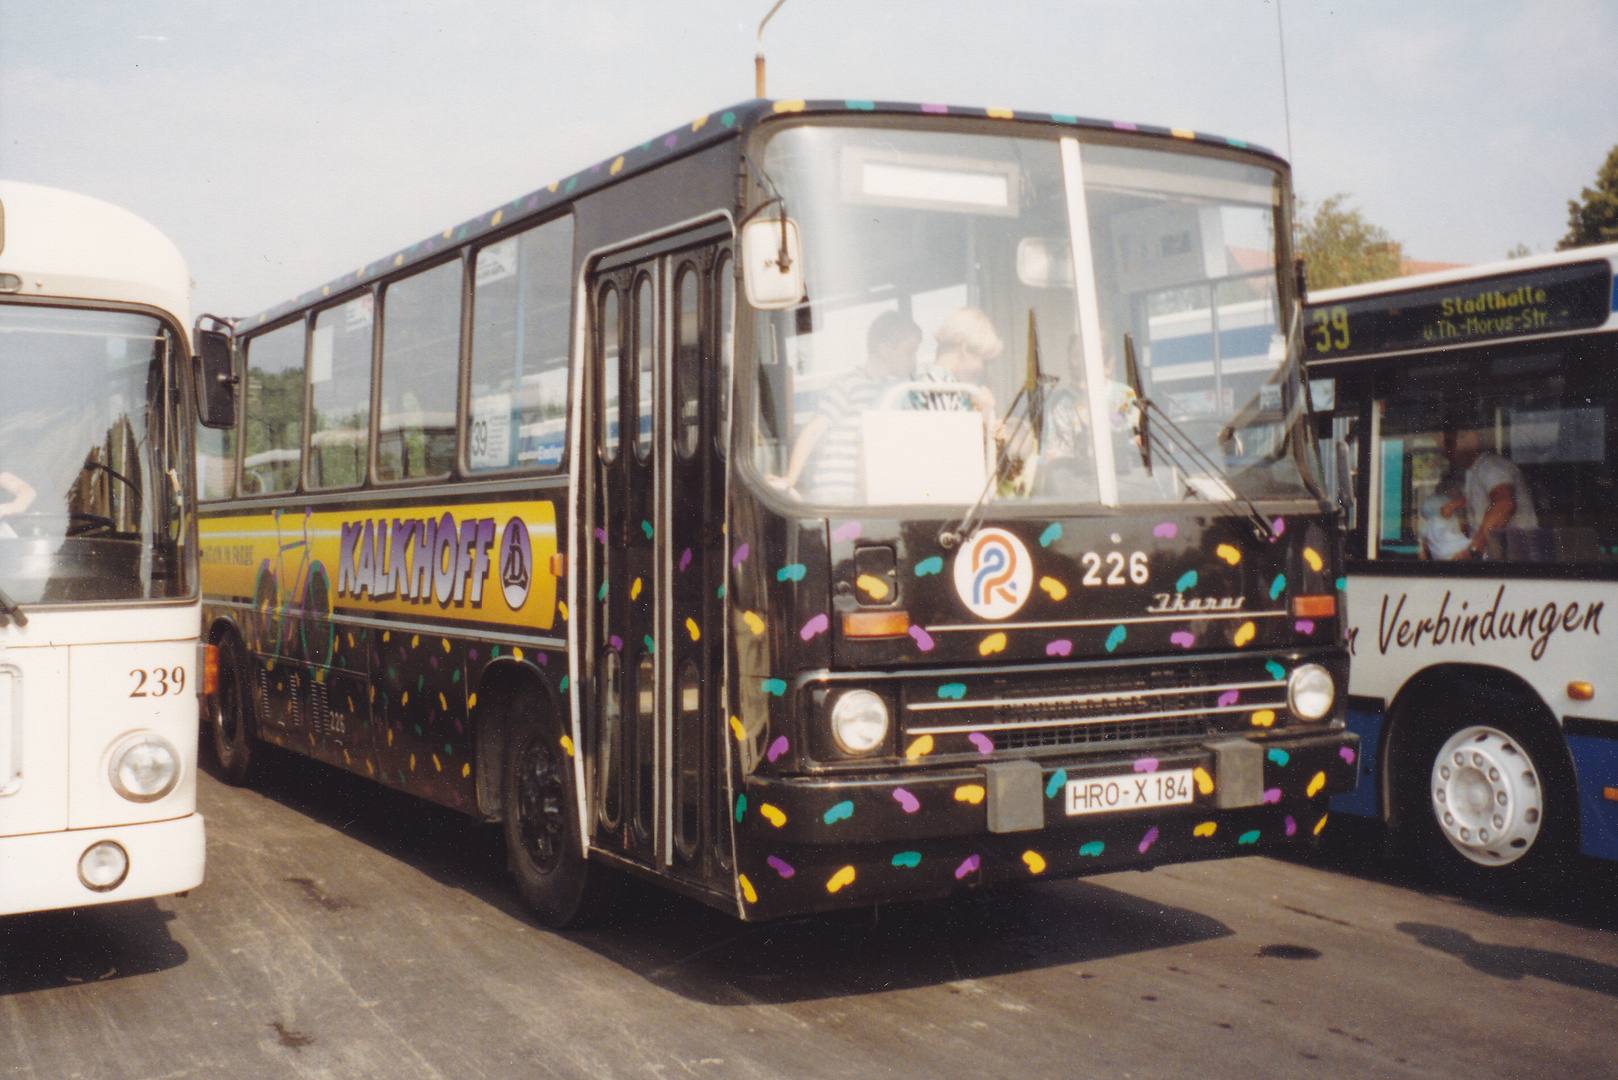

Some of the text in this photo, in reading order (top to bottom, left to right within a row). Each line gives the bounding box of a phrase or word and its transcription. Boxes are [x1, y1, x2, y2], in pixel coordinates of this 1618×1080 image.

[1441, 285, 1547, 317] Stadthalle
[1312, 306, 1350, 352] 39
[472, 420, 488, 456] 39
[338, 511, 497, 610] KALKHOFF
[1082, 551, 1149, 586] 226
[1146, 592, 1246, 613] Ikarus
[1378, 583, 1605, 661] Verbindungen
[129, 666, 187, 698] 239
[329, 710, 346, 734] 226
[1155, 775, 1188, 802] 184
